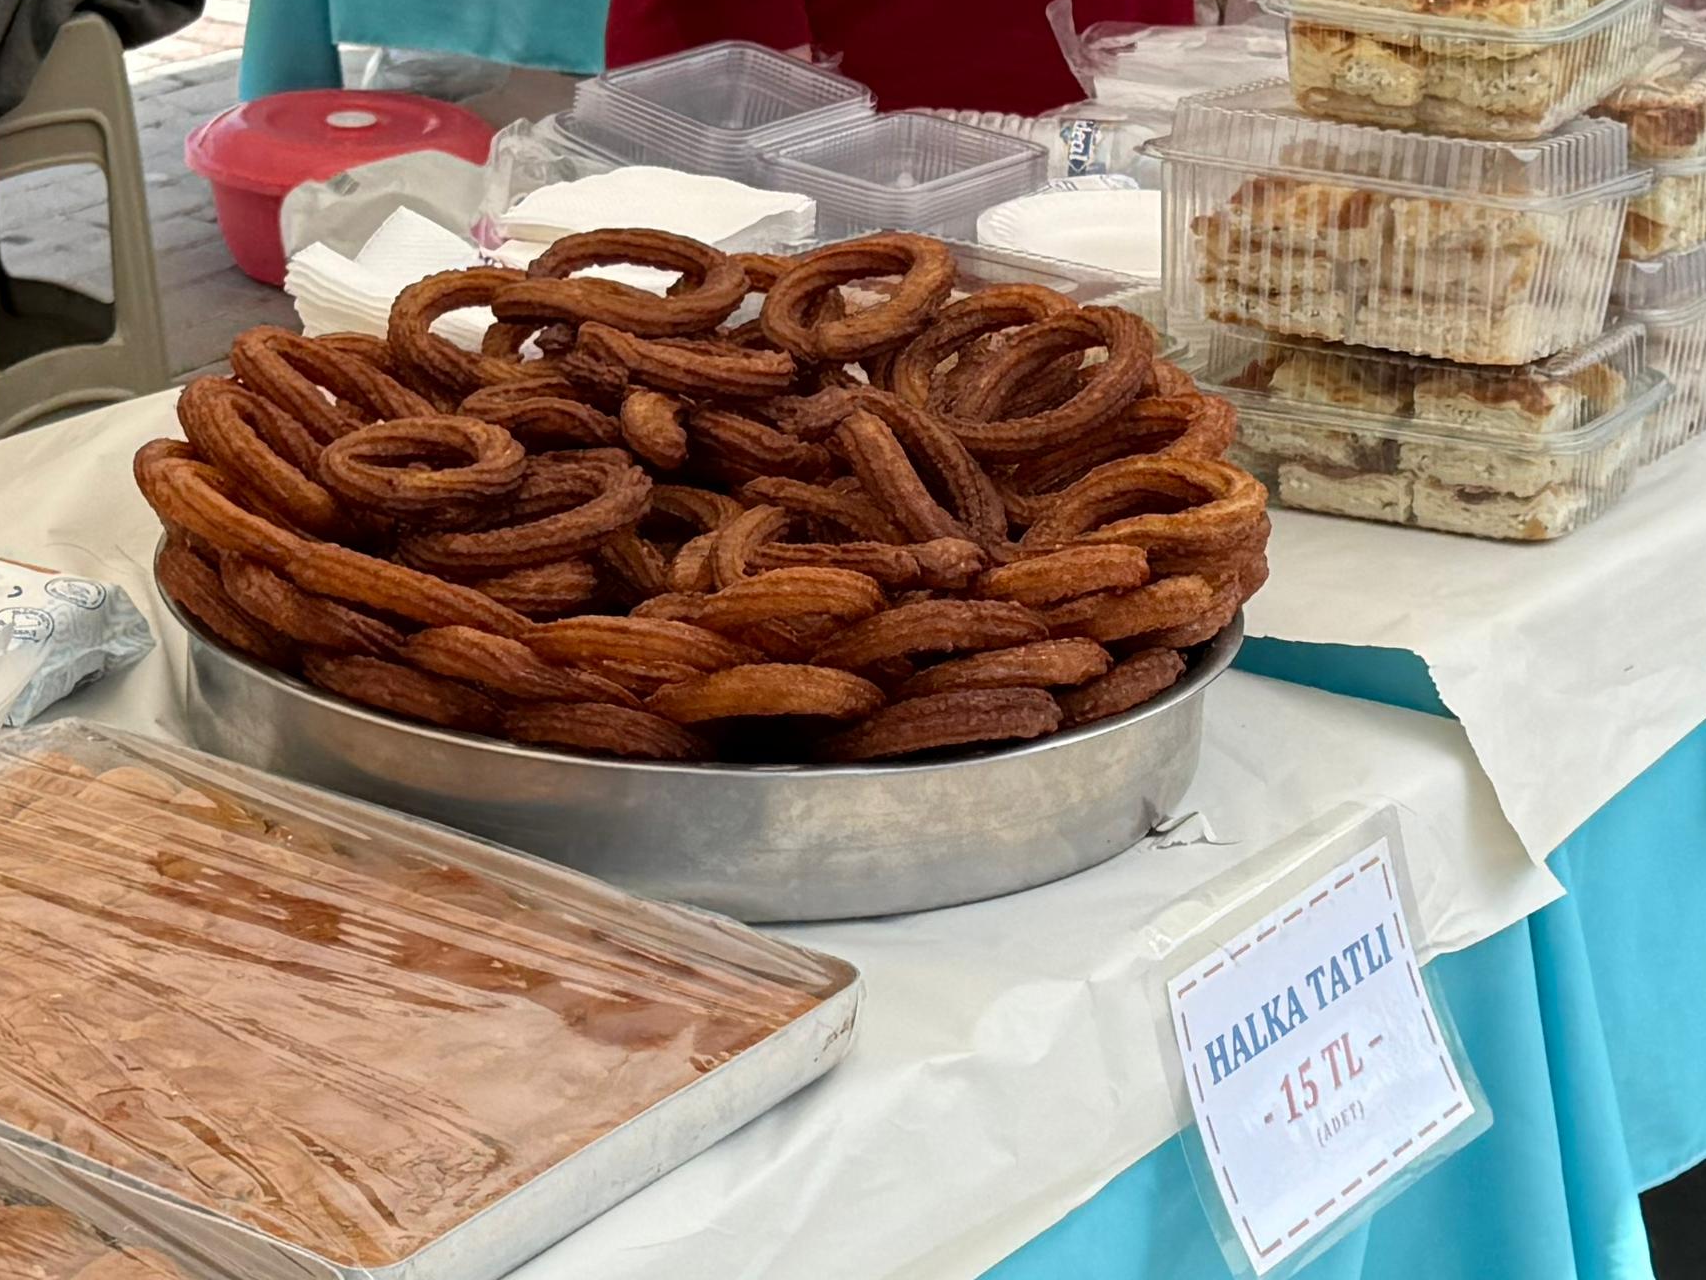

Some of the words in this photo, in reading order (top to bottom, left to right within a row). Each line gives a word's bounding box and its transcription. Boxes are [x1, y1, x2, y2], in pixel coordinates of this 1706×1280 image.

[1204, 985, 1308, 1085] HALKA
[1306, 922, 1394, 1011] TATLI
[1279, 1056, 1320, 1125] 15
[1321, 1031, 1365, 1092] TL
